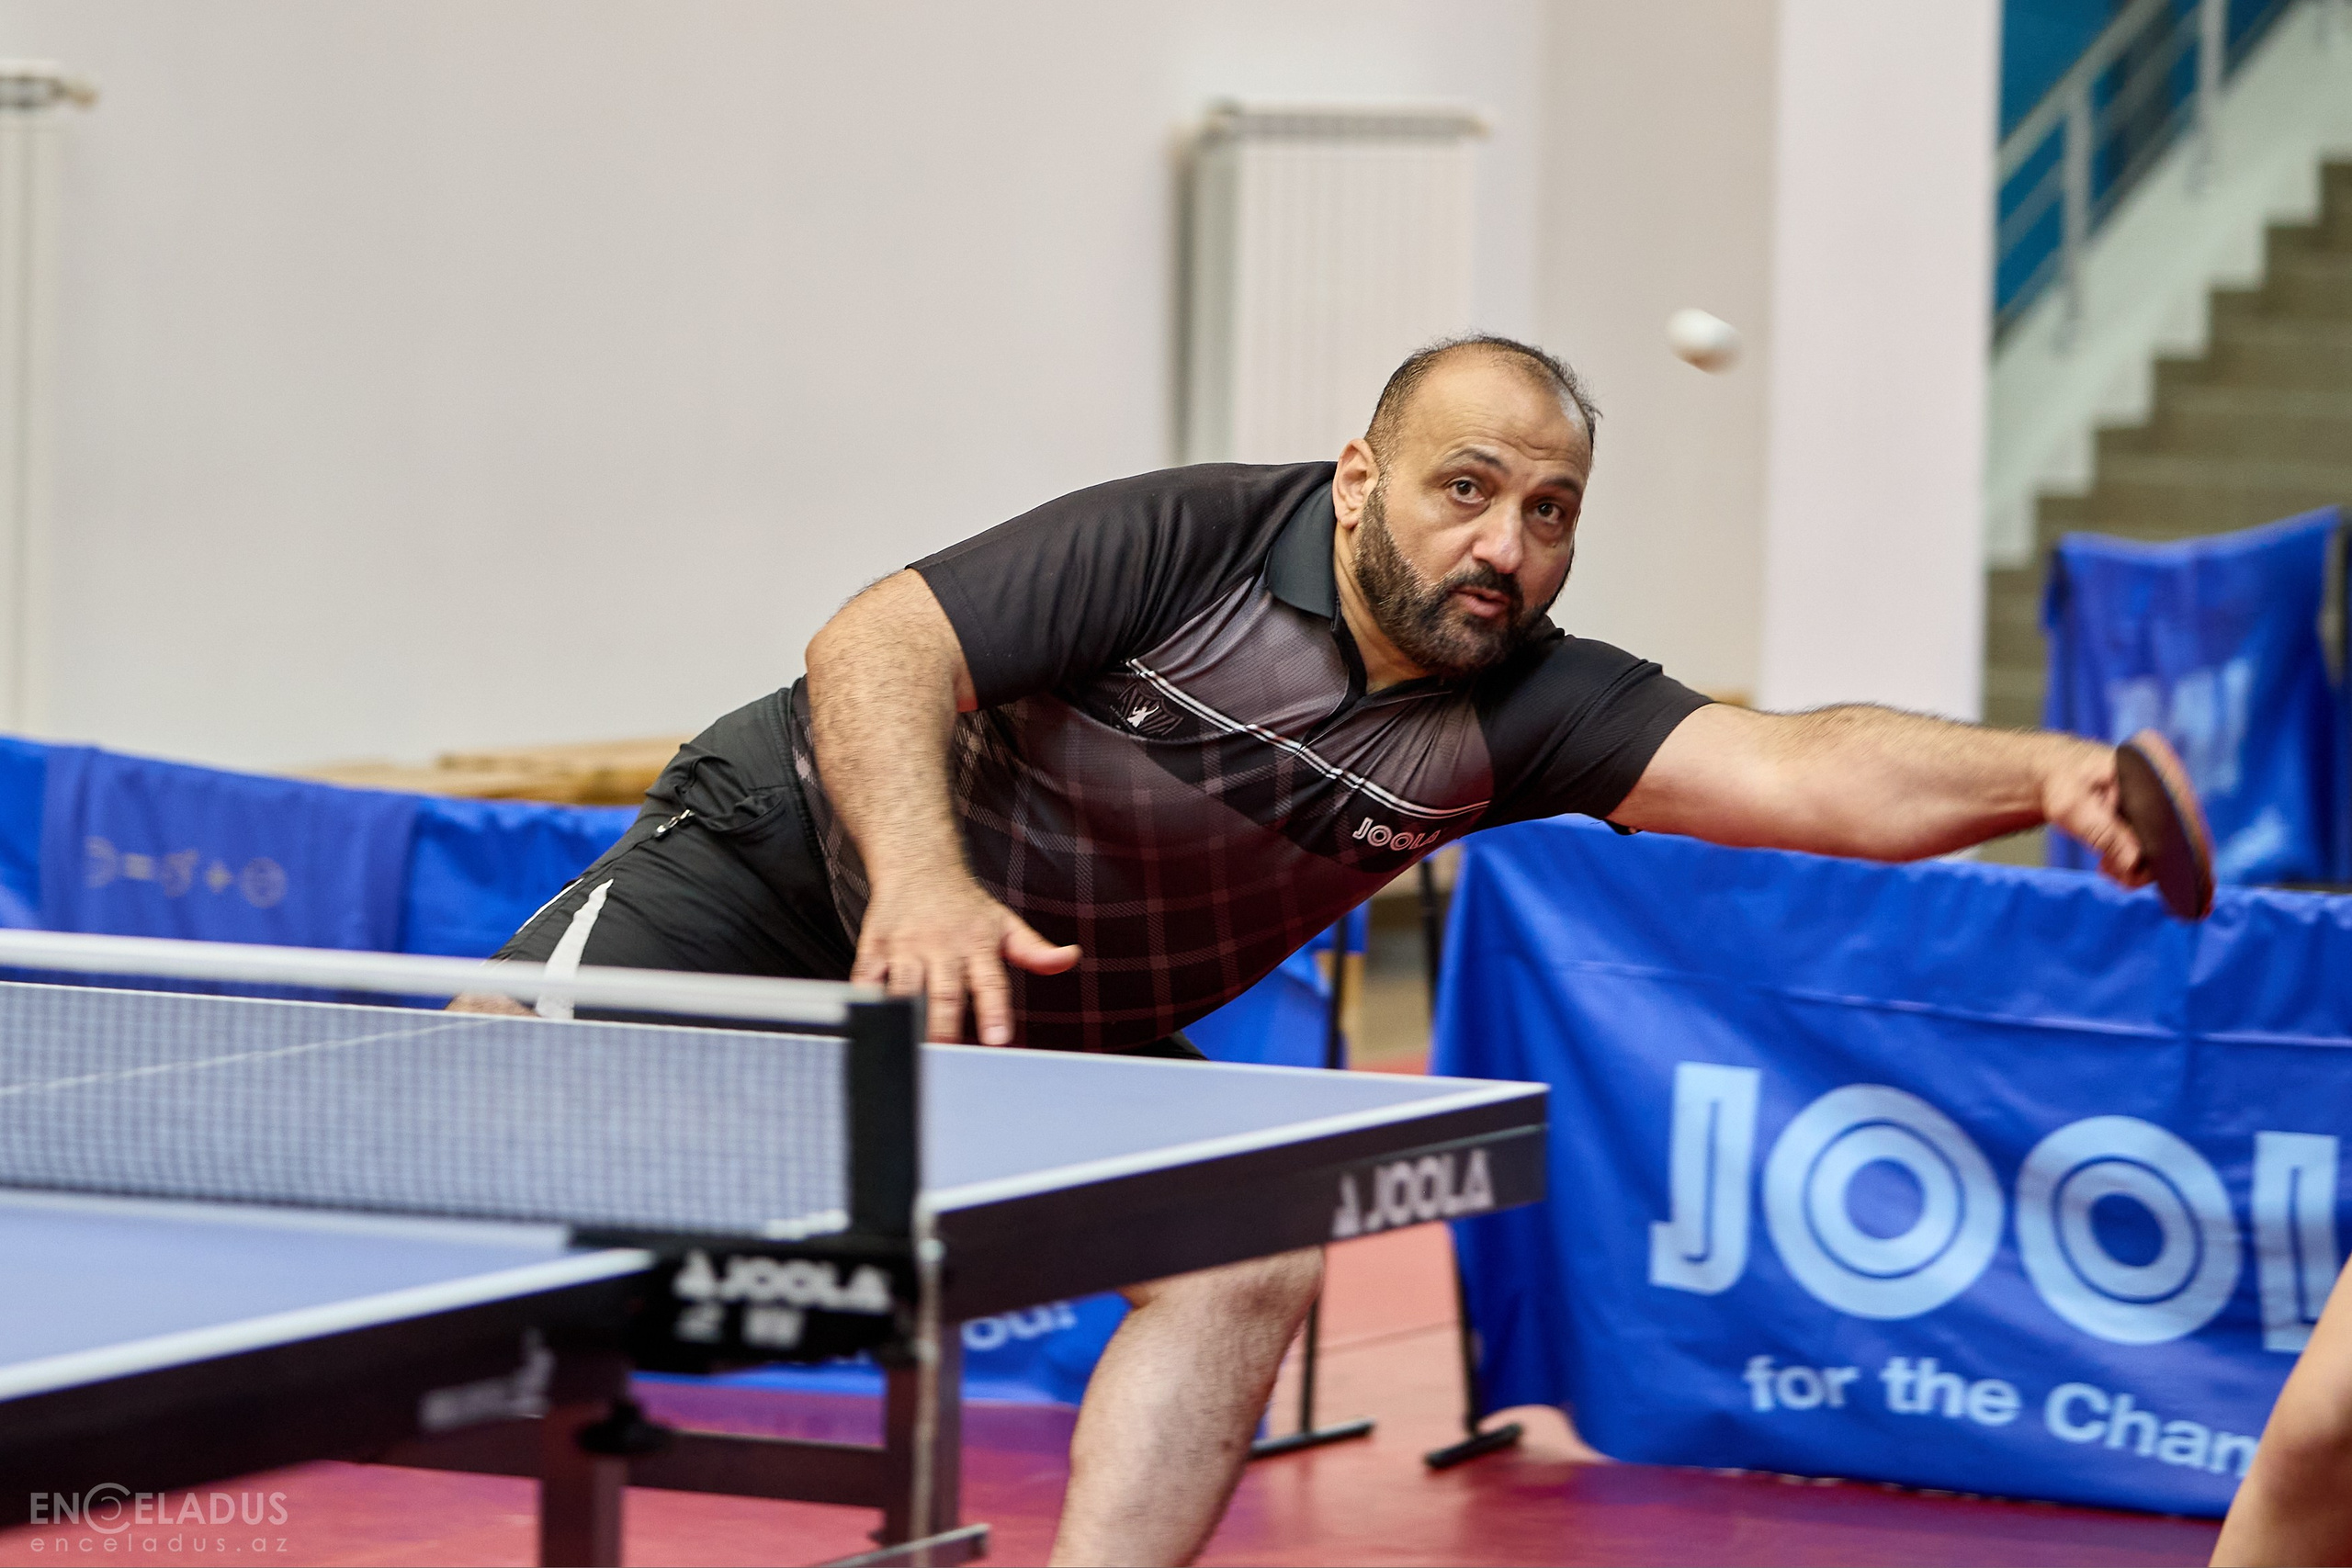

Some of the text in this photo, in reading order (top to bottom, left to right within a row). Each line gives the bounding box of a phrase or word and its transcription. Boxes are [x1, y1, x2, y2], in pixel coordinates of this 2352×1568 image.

[1352, 817, 1442, 852] JOOLA
[1365, 1149, 1496, 1233] JOOLA
[719, 1253, 892, 1314] JOOLA
[1747, 1354, 1858, 1412] for
[1881, 1355, 2021, 1426] the
